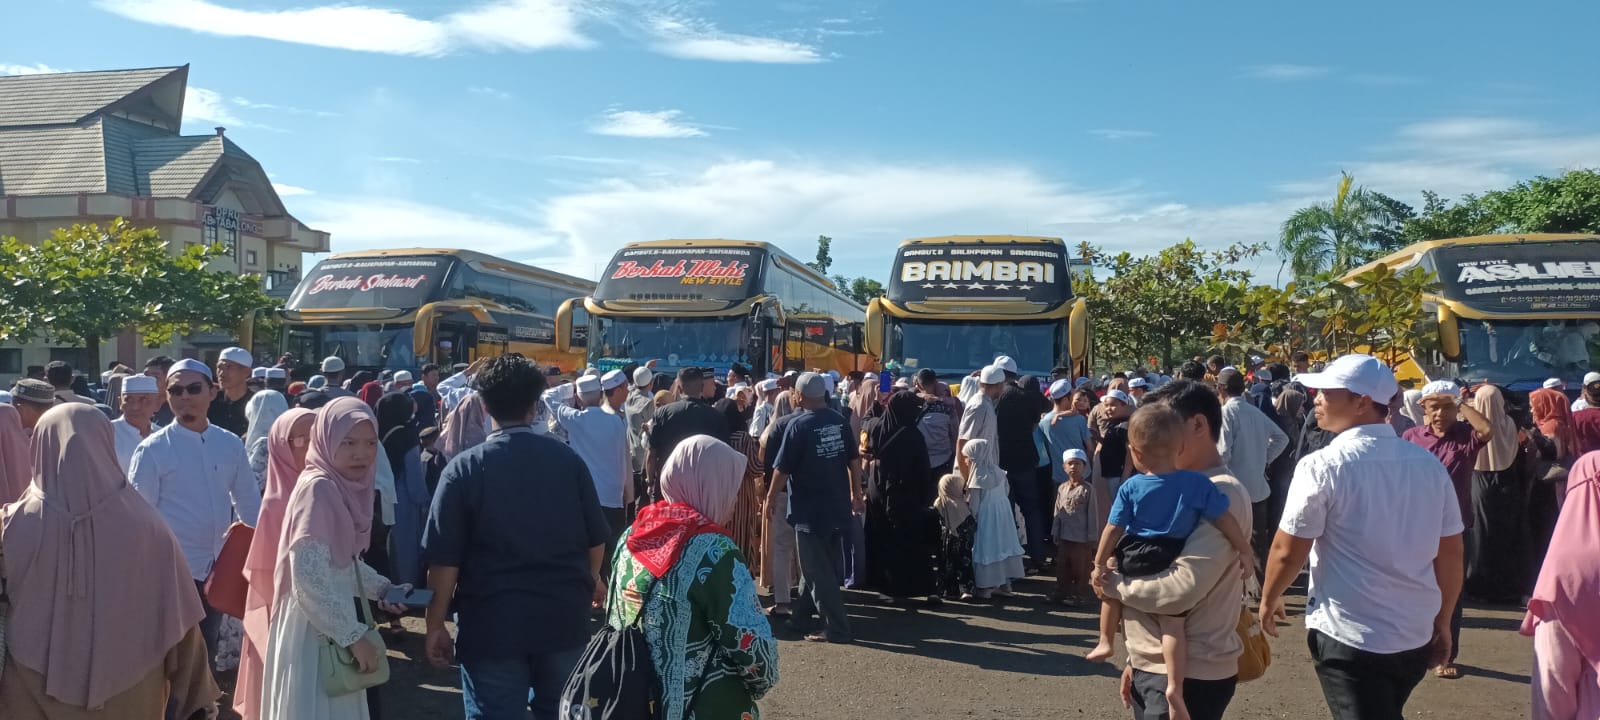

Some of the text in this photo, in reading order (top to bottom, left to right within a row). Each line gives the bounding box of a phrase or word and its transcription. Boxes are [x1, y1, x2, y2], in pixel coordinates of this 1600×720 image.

[216, 216, 257, 233] TABALONG
[1010, 249, 1059, 258] SAMARINDA
[611, 259, 750, 279] Berkah Illahi
[901, 260, 1055, 284] BAIMBAI
[309, 273, 428, 295] Berkah Sholawat
[680, 276, 744, 287] NEW STYLE
